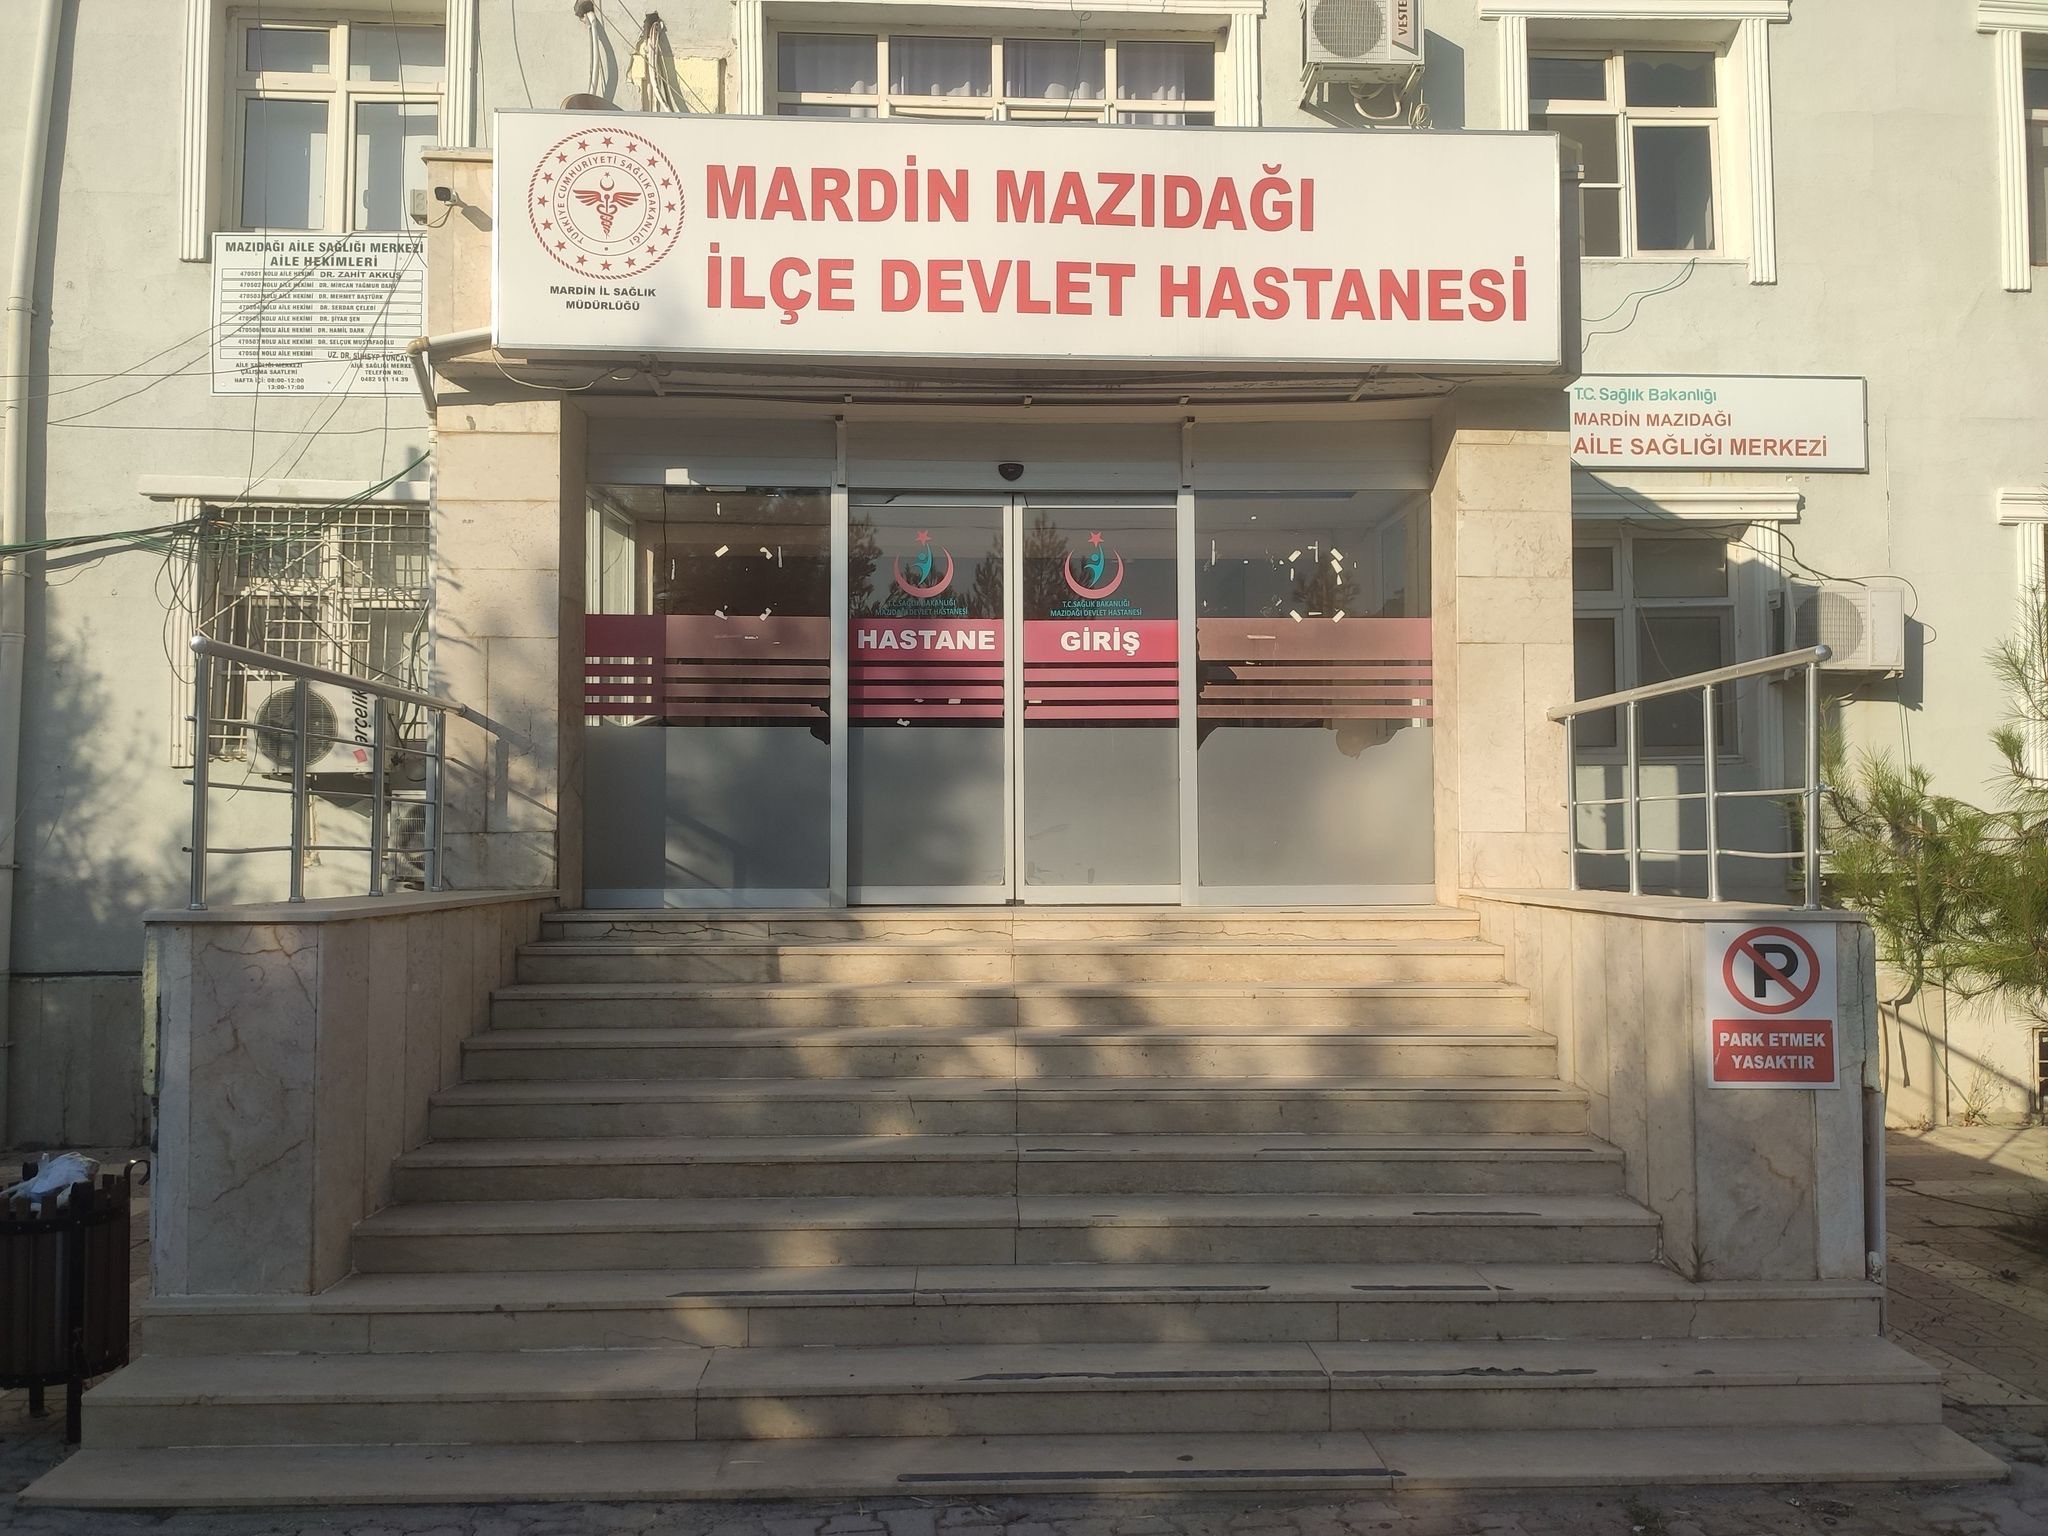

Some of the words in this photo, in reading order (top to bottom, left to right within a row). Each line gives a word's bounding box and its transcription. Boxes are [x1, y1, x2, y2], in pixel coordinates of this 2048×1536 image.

[557, 155, 618, 199] CUMHURİYETİ
[620, 157, 651, 190] SAĞLIK
[706, 154, 969, 222] MARDİN
[996, 163, 1315, 232] MAZIDAĞI
[557, 202, 584, 244] TÜRKİYE
[629, 192, 657, 246] BAKANLIĞI
[225, 240, 284, 252] MAZIDAĞI
[289, 240, 315, 252] AİLE
[319, 240, 366, 253] SAĞLIĞI
[370, 241, 424, 254] MERKEZİ
[270, 254, 299, 266] AİLE
[304, 254, 378, 267] HEKİMLERİ
[338, 270, 366, 278] ZAHİT
[550, 285, 595, 295] MARDİN
[600, 285, 610, 296] İL
[613, 286, 656, 297] SAĞLIK
[707, 242, 855, 325] İLÇE
[881, 259, 1136, 317] DEVLET
[1160, 256, 1527, 322] HASTANESİ
[566, 300, 640, 311] MÜDÜRLÜĞÜ
[1574, 387, 1597, 401] T.C.
[1599, 388, 1644, 404] Sağlık
[1649, 388, 1717, 405] Bakanlığı
[1574, 410, 1640, 427] MARDİN
[1646, 410, 1732, 427] MAZIDAĞI
[1573, 433, 1623, 456] AİLE
[1630, 433, 1722, 456] SAĞLIĞI
[1730, 435, 1827, 457] MERKEZİ
[934, 607, 968, 615] HASTANESİ
[1097, 599, 1130, 607] BAKANLIĞI
[1050, 608, 1083, 617] MAZIDAĞI
[1108, 607, 1142, 616] HASTANESİ
[858, 629, 996, 651] HASTANE
[1060, 626, 1141, 656] GİRİŞ
[352, 688, 372, 743] arçelik
[1753, 944, 1799, 998] P
[1720, 1032, 1764, 1047] PARK
[1769, 1033, 1826, 1048] ETMEK
[1732, 1055, 1815, 1070] YASAKTIR
